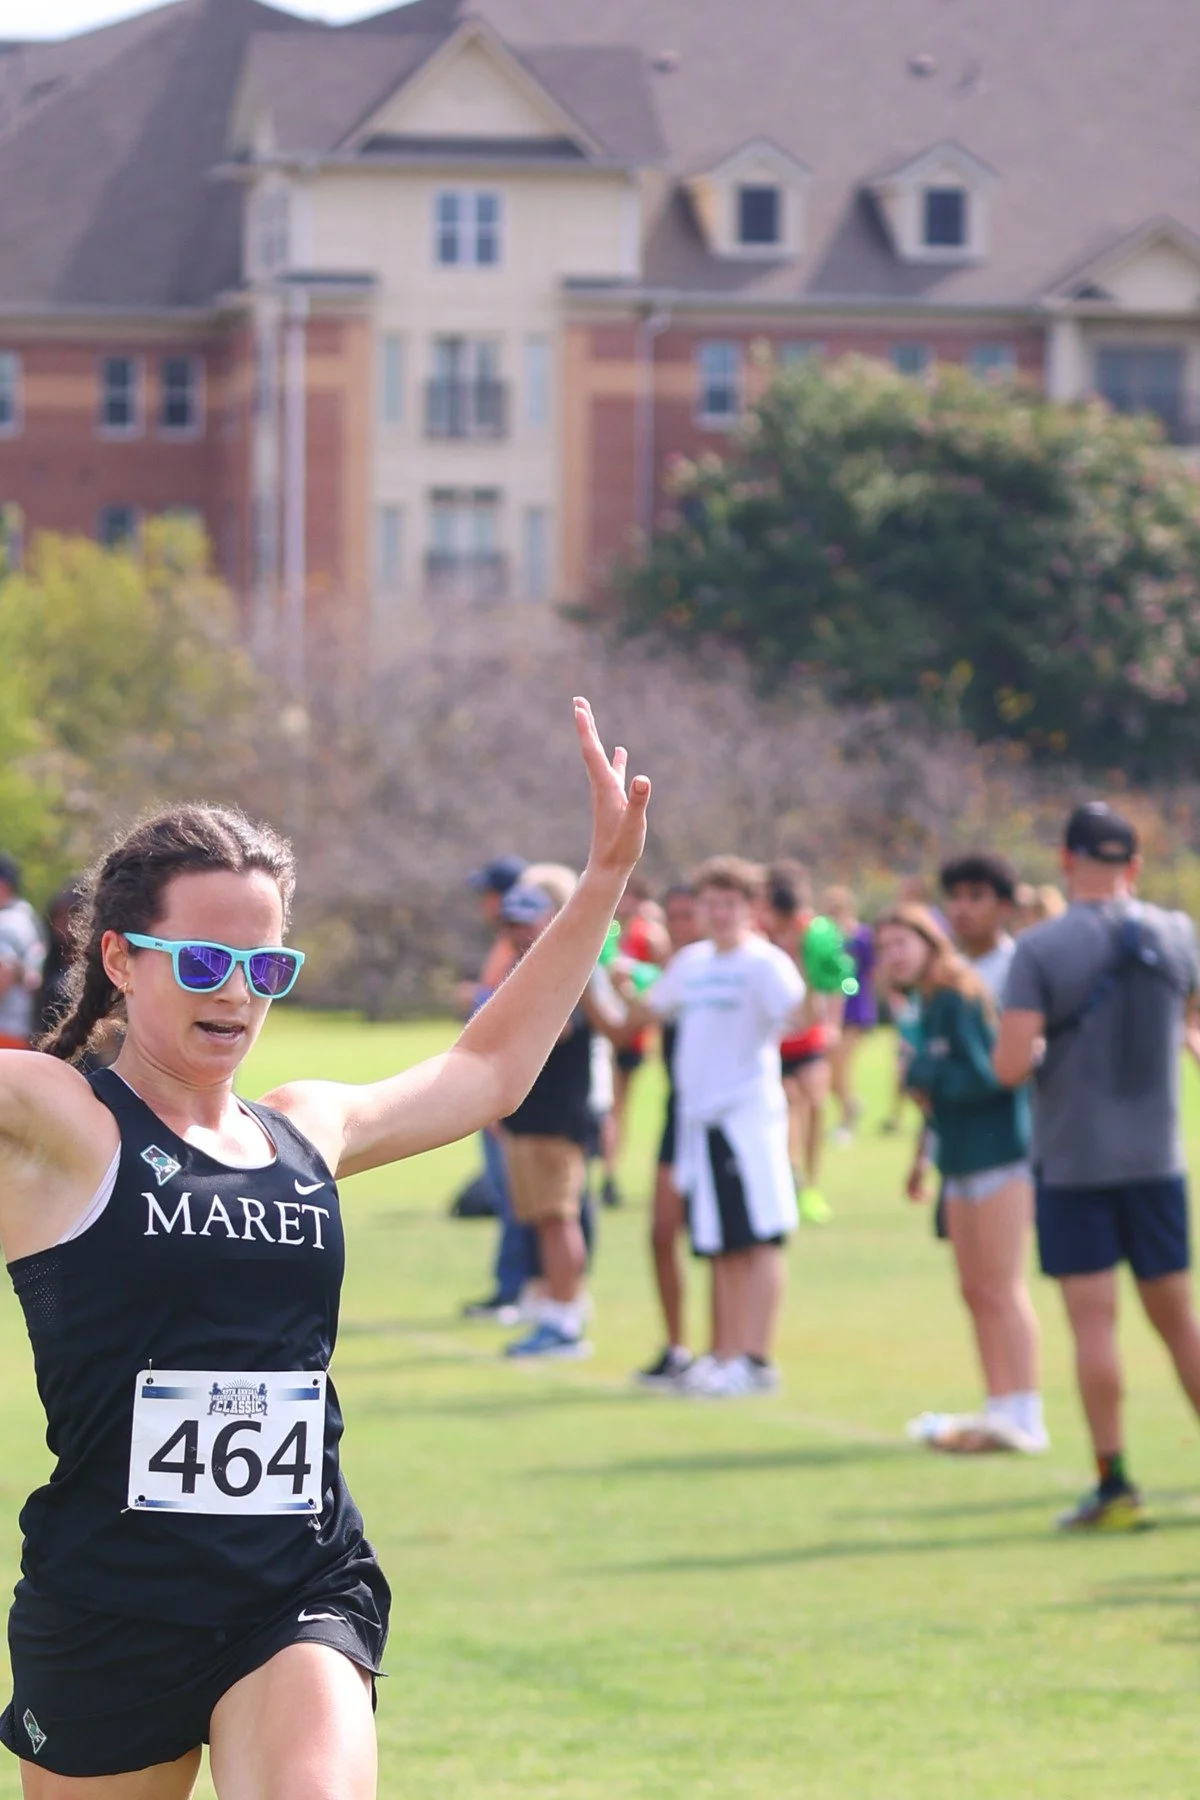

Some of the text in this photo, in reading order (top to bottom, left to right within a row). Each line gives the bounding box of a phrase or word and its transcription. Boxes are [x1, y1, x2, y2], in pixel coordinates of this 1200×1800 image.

[141, 1192, 330, 1250] MARET
[215, 1400, 264, 1413] CLASSIC
[148, 1420, 311, 1497] 464
